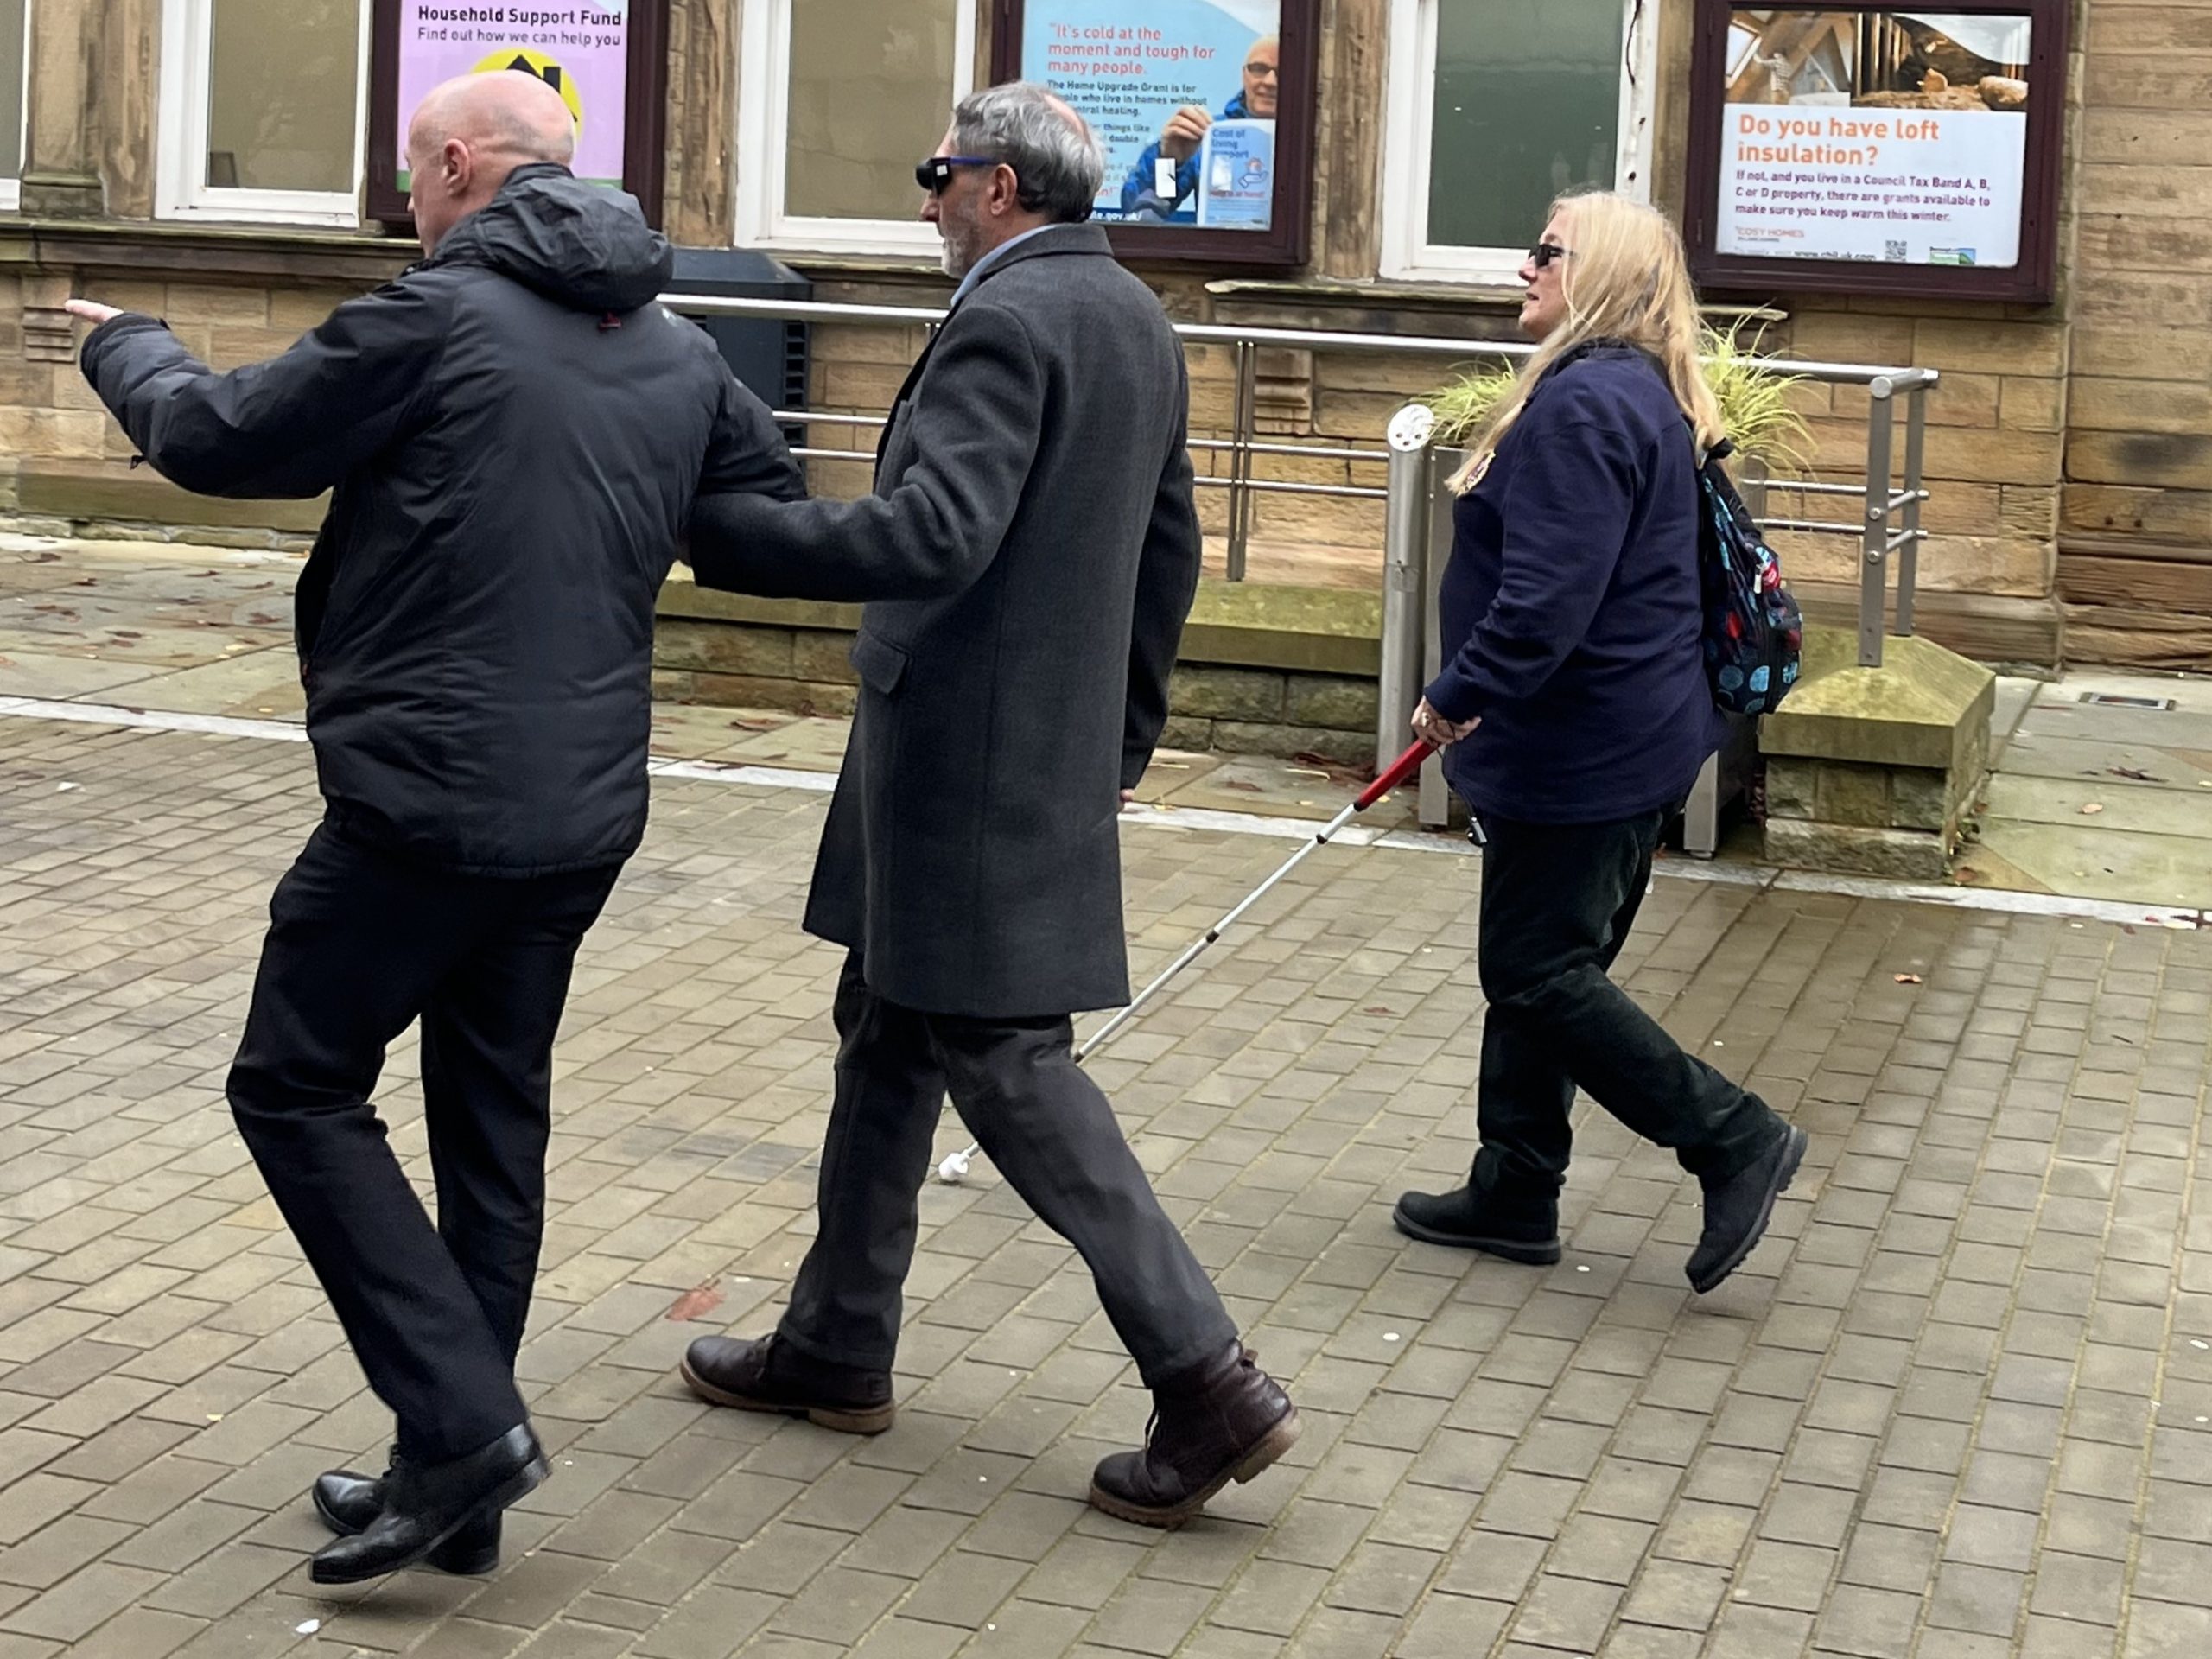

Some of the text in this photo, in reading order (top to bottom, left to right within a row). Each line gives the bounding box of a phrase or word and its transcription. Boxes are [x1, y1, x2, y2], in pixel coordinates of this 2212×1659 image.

[418, 5, 621, 27] Household Support Fund
[418, 27, 620, 48] Find out how we can help you
[1084, 25, 1115, 40] cold
[1118, 27, 1134, 40] at
[1137, 26, 1162, 41] the
[1048, 43, 1216, 61] moment and tough for
[1048, 60, 1147, 76] many people.
[1047, 79, 1197, 93] The Home Upgrade Grant is for
[1081, 93, 1101, 103] who
[1103, 93, 1122, 103] live
[1123, 94, 1133, 103] in
[1135, 95, 1167, 105] homes
[1170, 96, 1208, 106] without
[1103, 105, 1142, 118] heating.
[1740, 114, 1940, 140] Do you have loft
[1738, 140, 1878, 166] insulation?
[1737, 169, 1745, 180] If
[1747, 171, 1769, 182] not,
[1771, 171, 1792, 181] and
[1795, 173, 1815, 185] you
[1817, 172, 1838, 183] live
[1840, 173, 1851, 184] in
[1853, 175, 1861, 184] a
[1863, 174, 1906, 187] Council
[1909, 175, 1929, 188] Tax
[1932, 176, 1961, 188] Band
[1735, 186, 1990, 207] C or D property, there are grants available to
[1735, 204, 1951, 222] make sure you keep warm this winter.
